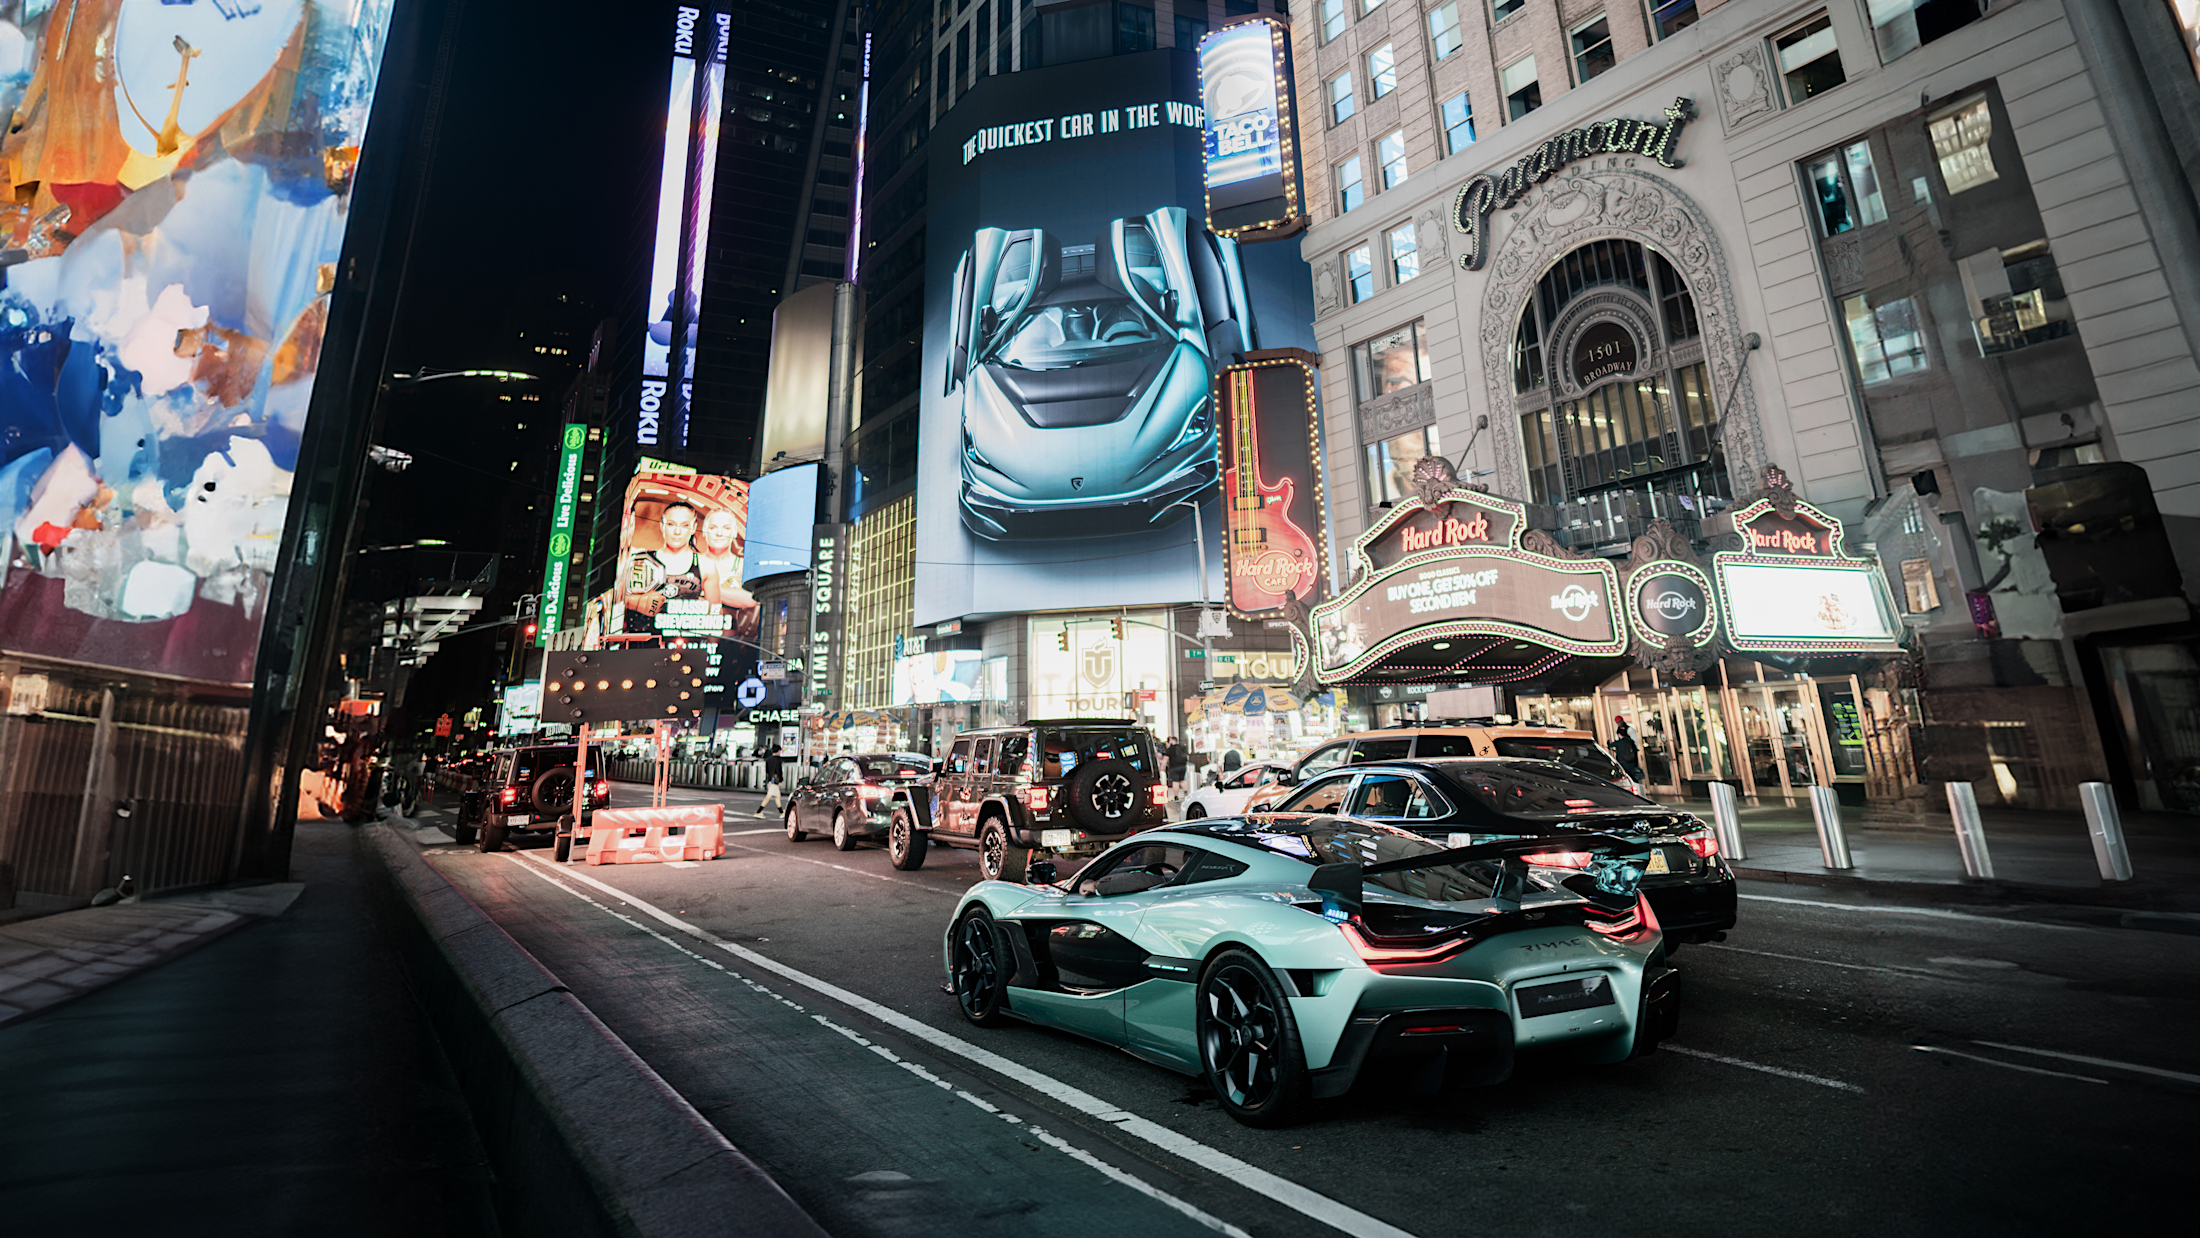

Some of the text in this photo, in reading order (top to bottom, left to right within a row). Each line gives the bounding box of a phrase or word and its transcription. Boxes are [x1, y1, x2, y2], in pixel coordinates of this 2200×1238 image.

[962, 134, 977, 165] THE
[977, 118, 1054, 154] QUICKEST
[1059, 113, 1094, 139] CAR
[1100, 109, 1119, 133] IN
[1125, 103, 1159, 129] THE
[1213, 114, 1270, 140] TACO
[1217, 131, 1272, 156] BELL
[1453, 97, 1692, 271] Paramount
[1589, 341, 1620, 362] 1501
[1584, 361, 1632, 385] BROADWAY
[556, 453, 577, 528] Live Delicious
[1402, 512, 1489, 552] Hard Rock
[1781, 530, 1817, 553] Rock
[816, 537, 834, 613] SQUARE
[1235, 557, 1313, 578] Hard Rock
[1264, 577, 1287, 587] CAFE
[1387, 585, 1408, 601] BUY
[1432, 577, 1453, 594] GET
[1453, 572, 1476, 591] 50%
[1475, 569, 1498, 587] OFF
[1410, 594, 1452, 614] SECOND
[1646, 597, 1696, 610] Hard Rock
[724, 614, 733, 630] 3
[903, 634, 928, 656] AT&T
[811, 631, 830, 691] TIMES
[1407, 684, 1436, 695] ROCK SHOP
[749, 709, 800, 723] CHASE
[1520, 938, 1581, 952] RIMAC
